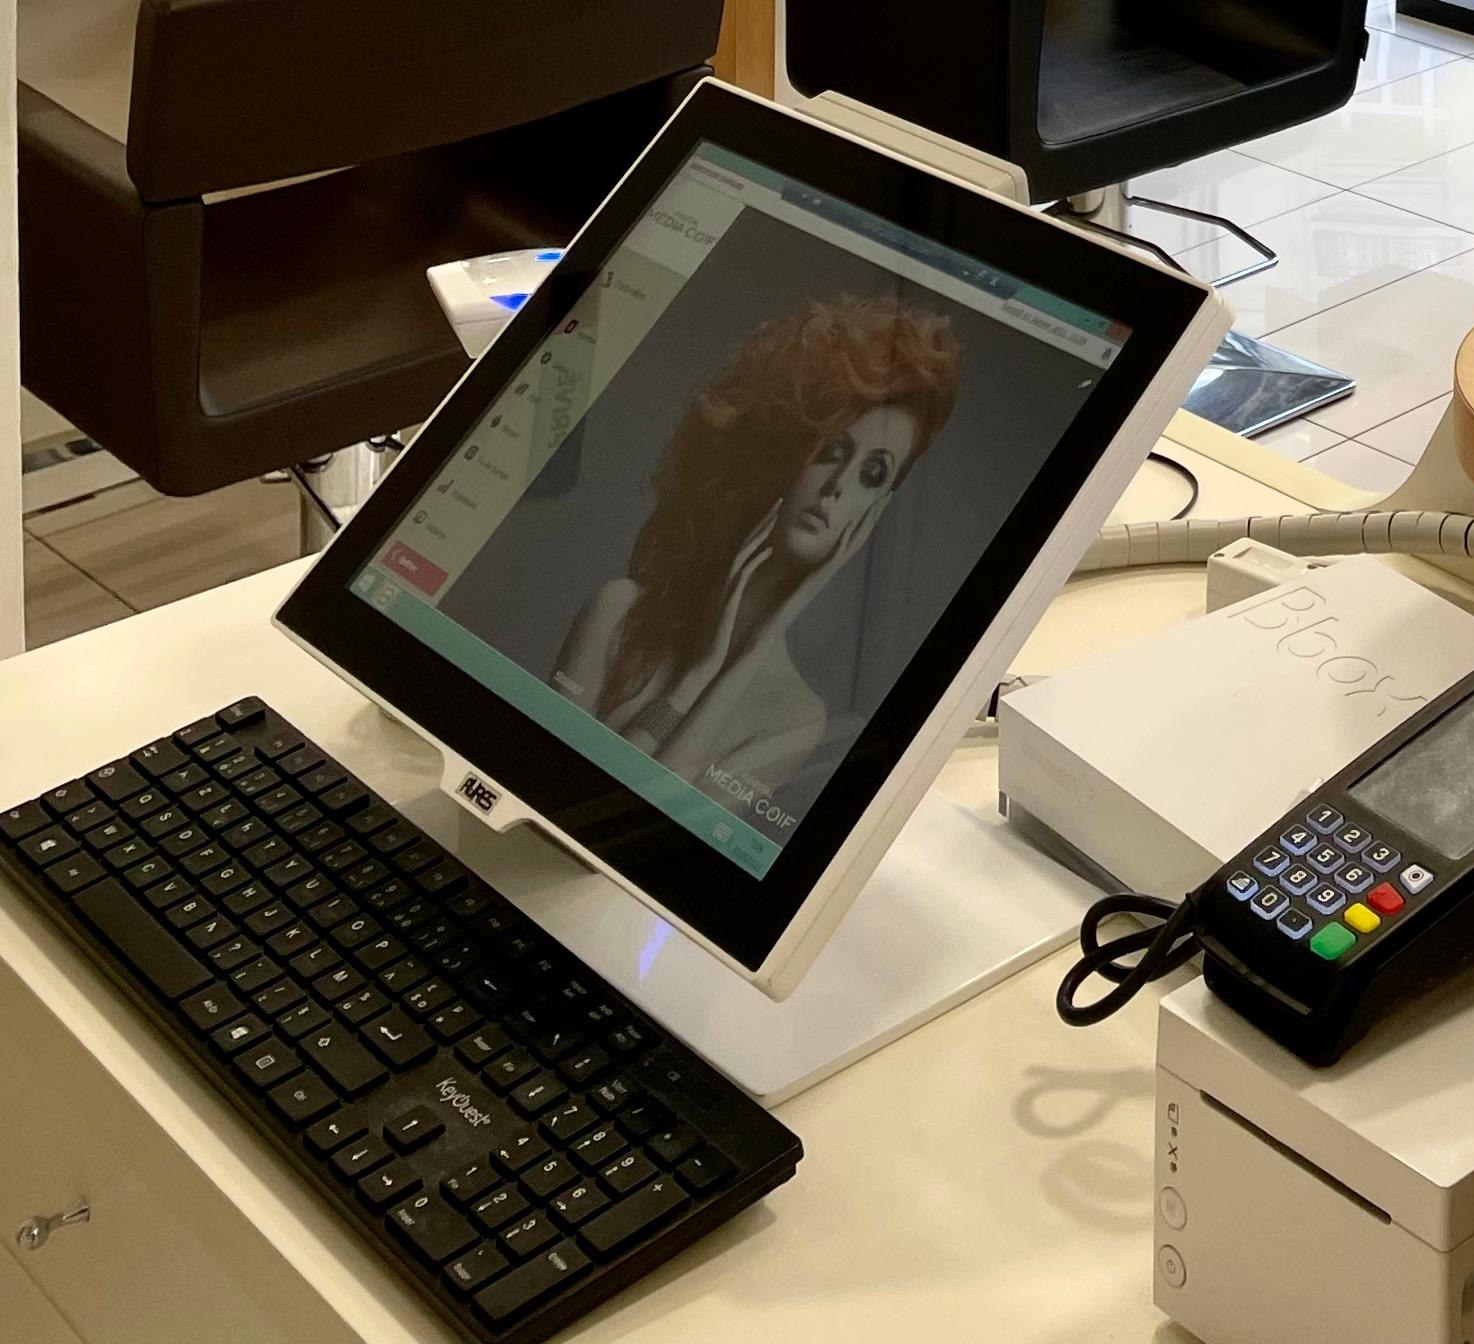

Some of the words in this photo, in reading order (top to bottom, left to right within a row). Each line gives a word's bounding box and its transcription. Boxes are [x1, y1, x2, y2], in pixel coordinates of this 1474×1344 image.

[704, 763, 753, 808] MEDIA
[755, 799, 797, 829] COIF
[1319, 810, 1332, 822] 1
[1291, 832, 1307, 844] 4
[1343, 829, 1361, 843] 2
[1263, 851, 1281, 863] 7
[1317, 848, 1335, 863] 5
[1372, 847, 1390, 861] 3
[1289, 870, 1307, 883] 8
[1345, 868, 1363, 881] 6
[1261, 892, 1278, 907] 0
[1317, 889, 1335, 902] 9
